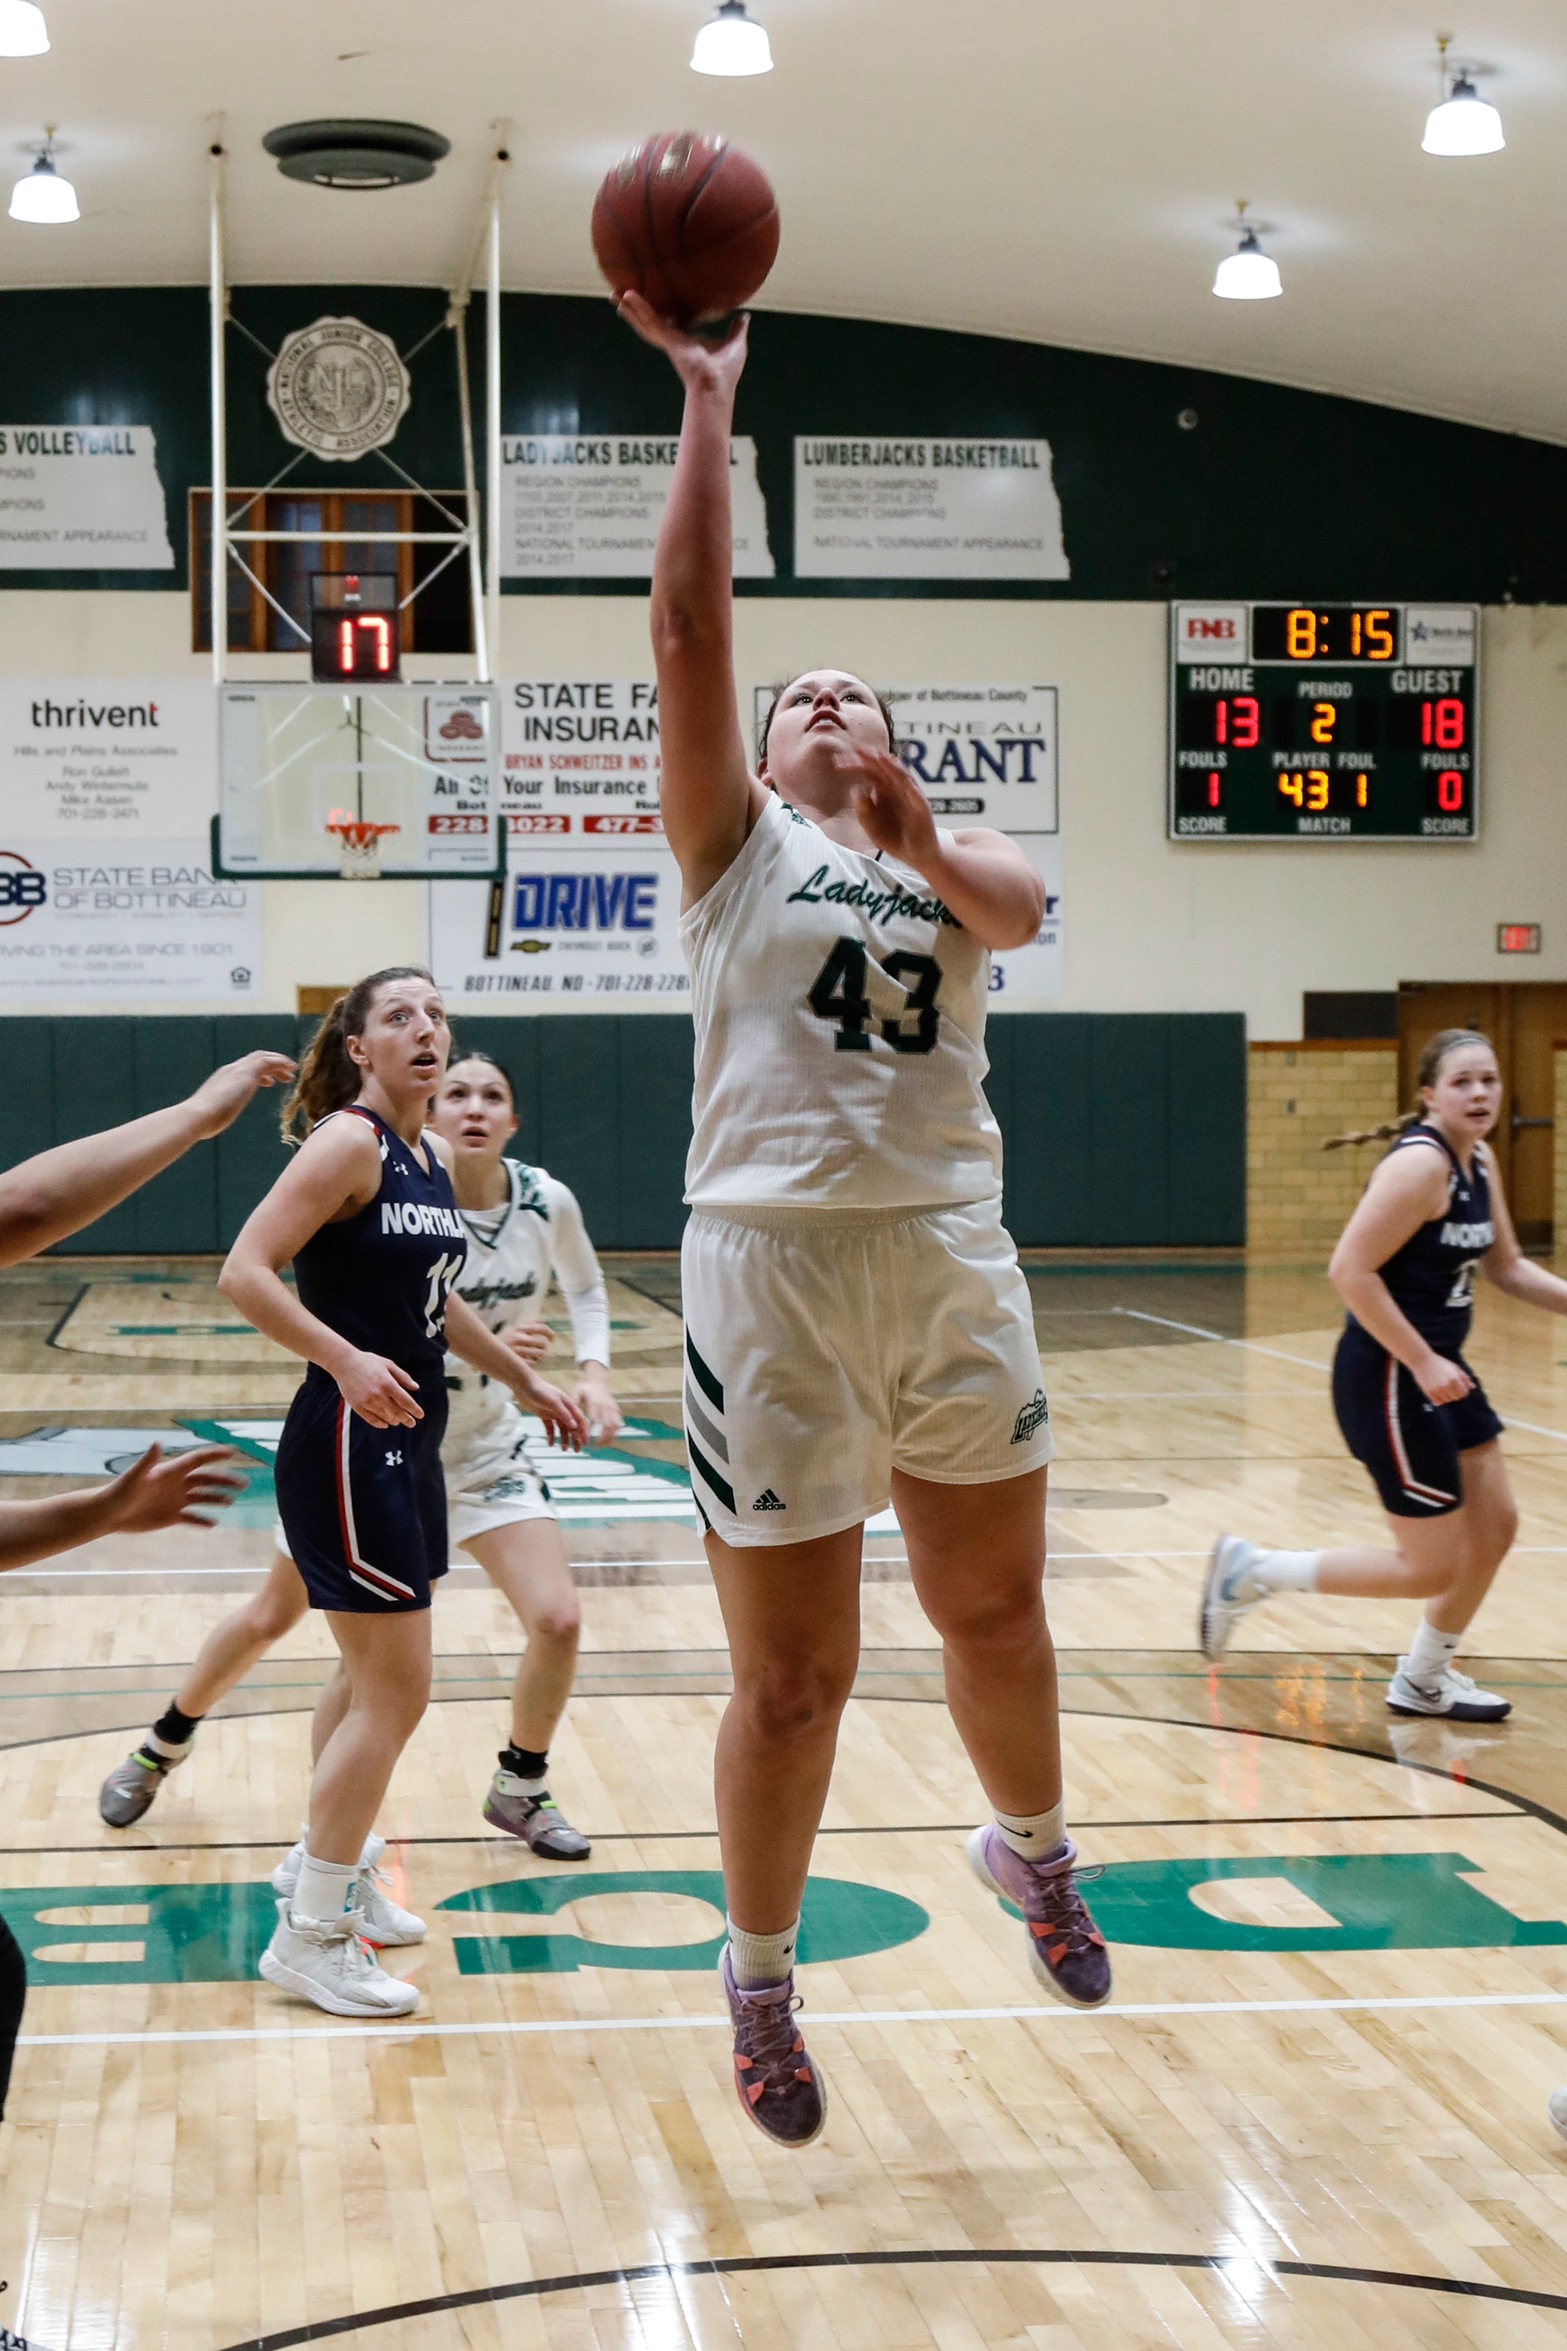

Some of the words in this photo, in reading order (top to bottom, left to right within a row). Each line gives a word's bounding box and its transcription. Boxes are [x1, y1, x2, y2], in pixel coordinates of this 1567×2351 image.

[14, 431, 136, 456] VOLLEYBALL
[804, 442, 926, 466] LUMBERJACKS
[932, 444, 1039, 468] BASKETBALL
[578, 537, 656, 550] TOURNAMEN
[341, 617, 390, 671] 17
[1287, 609, 1393, 660] 8:15
[1189, 669, 1254, 691] HOME
[1299, 682, 1353, 699] PERIOD
[1391, 670, 1464, 693] GUEST
[515, 683, 613, 709] STATE
[31, 699, 159, 727] thrivent
[1215, 697, 1259, 747] 13
[1310, 703, 1336, 743] 2
[1421, 699, 1464, 749] 18
[525, 716, 660, 742] INSURAN
[903, 721, 1042, 735] TINEAU
[44, 745, 67, 757] and
[897, 738, 1046, 783] RANT
[1179, 752, 1227, 768] FOULS
[1273, 752, 1330, 769] PLAYER
[1338, 753, 1377, 769] FOUL
[1421, 753, 1469, 770] FOULS
[505, 755, 543, 770] BRYAN
[549, 756, 623, 770] SCHWEITZER
[629, 756, 647, 770] INS
[503, 775, 544, 795] Your
[555, 775, 646, 795] Insurance
[1208, 772, 1219, 807] 1
[1278, 770, 1329, 810] 43
[1357, 773, 1367, 807] 1
[1438, 771, 1463, 811] 0
[1179, 817, 1227, 833] SCORE
[1298, 817, 1351, 833] MATCH
[1421, 818, 1469, 834] SCORE
[53, 867, 145, 887] STATE
[151, 867, 238, 887] BAN
[53, 891, 88, 910] OF
[93, 891, 248, 910] BOTTINEAU
[513, 873, 657, 931] DRIVE
[50, 944, 79, 957] THE
[85, 943, 132, 955] AREA
[136, 943, 187, 955] SINCE
[562, 975, 583, 992] ND
[806, 935, 944, 1055] 43
[752, 1501, 787, 1511] adidas
